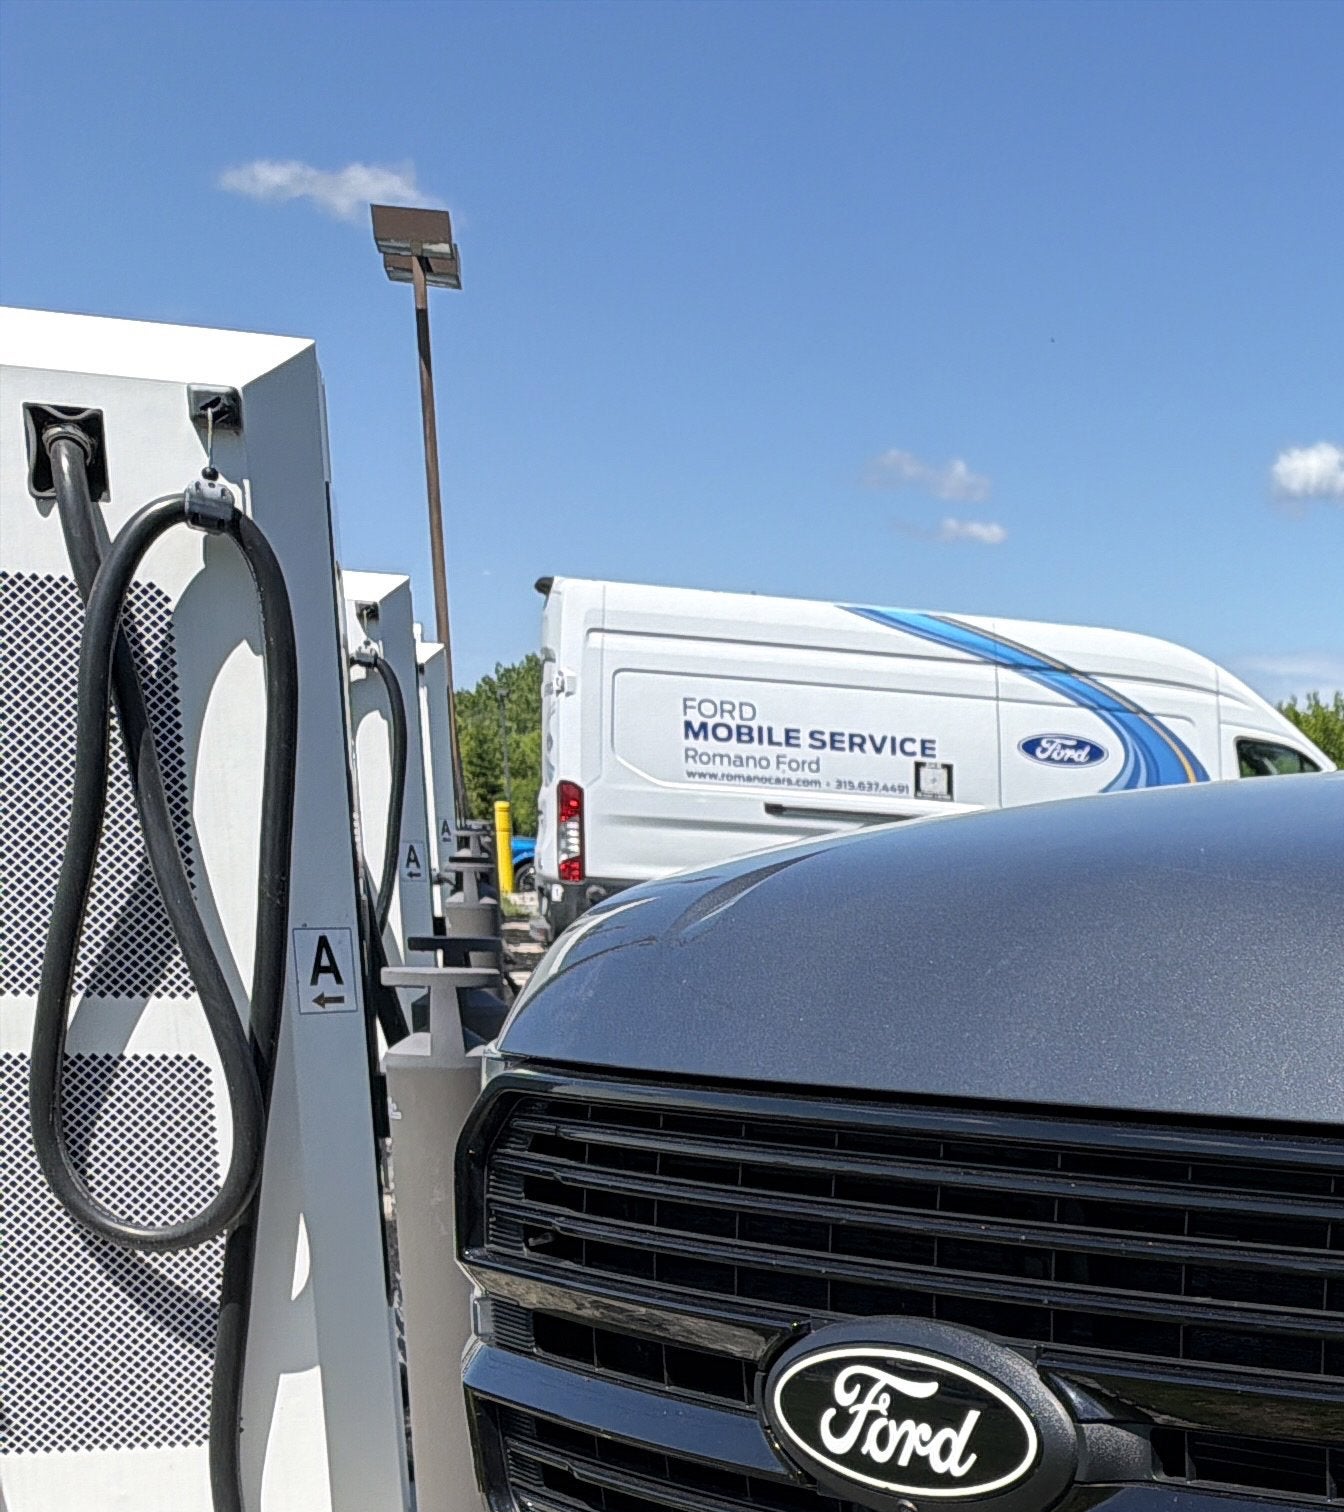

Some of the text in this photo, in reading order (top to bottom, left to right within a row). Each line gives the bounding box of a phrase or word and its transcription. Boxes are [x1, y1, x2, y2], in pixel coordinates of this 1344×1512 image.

[682, 697, 757, 722] FORD
[683, 719, 937, 759] MOBILE SERVICE
[1035, 738, 1091, 763] Ford
[684, 747, 821, 774] Romano Ford
[685, 770, 822, 789] www.romanocars.com
[441, 819, 451, 836] A
[406, 844, 420, 868] A
[310, 935, 344, 986] A
[820, 1364, 982, 1478] Ford
